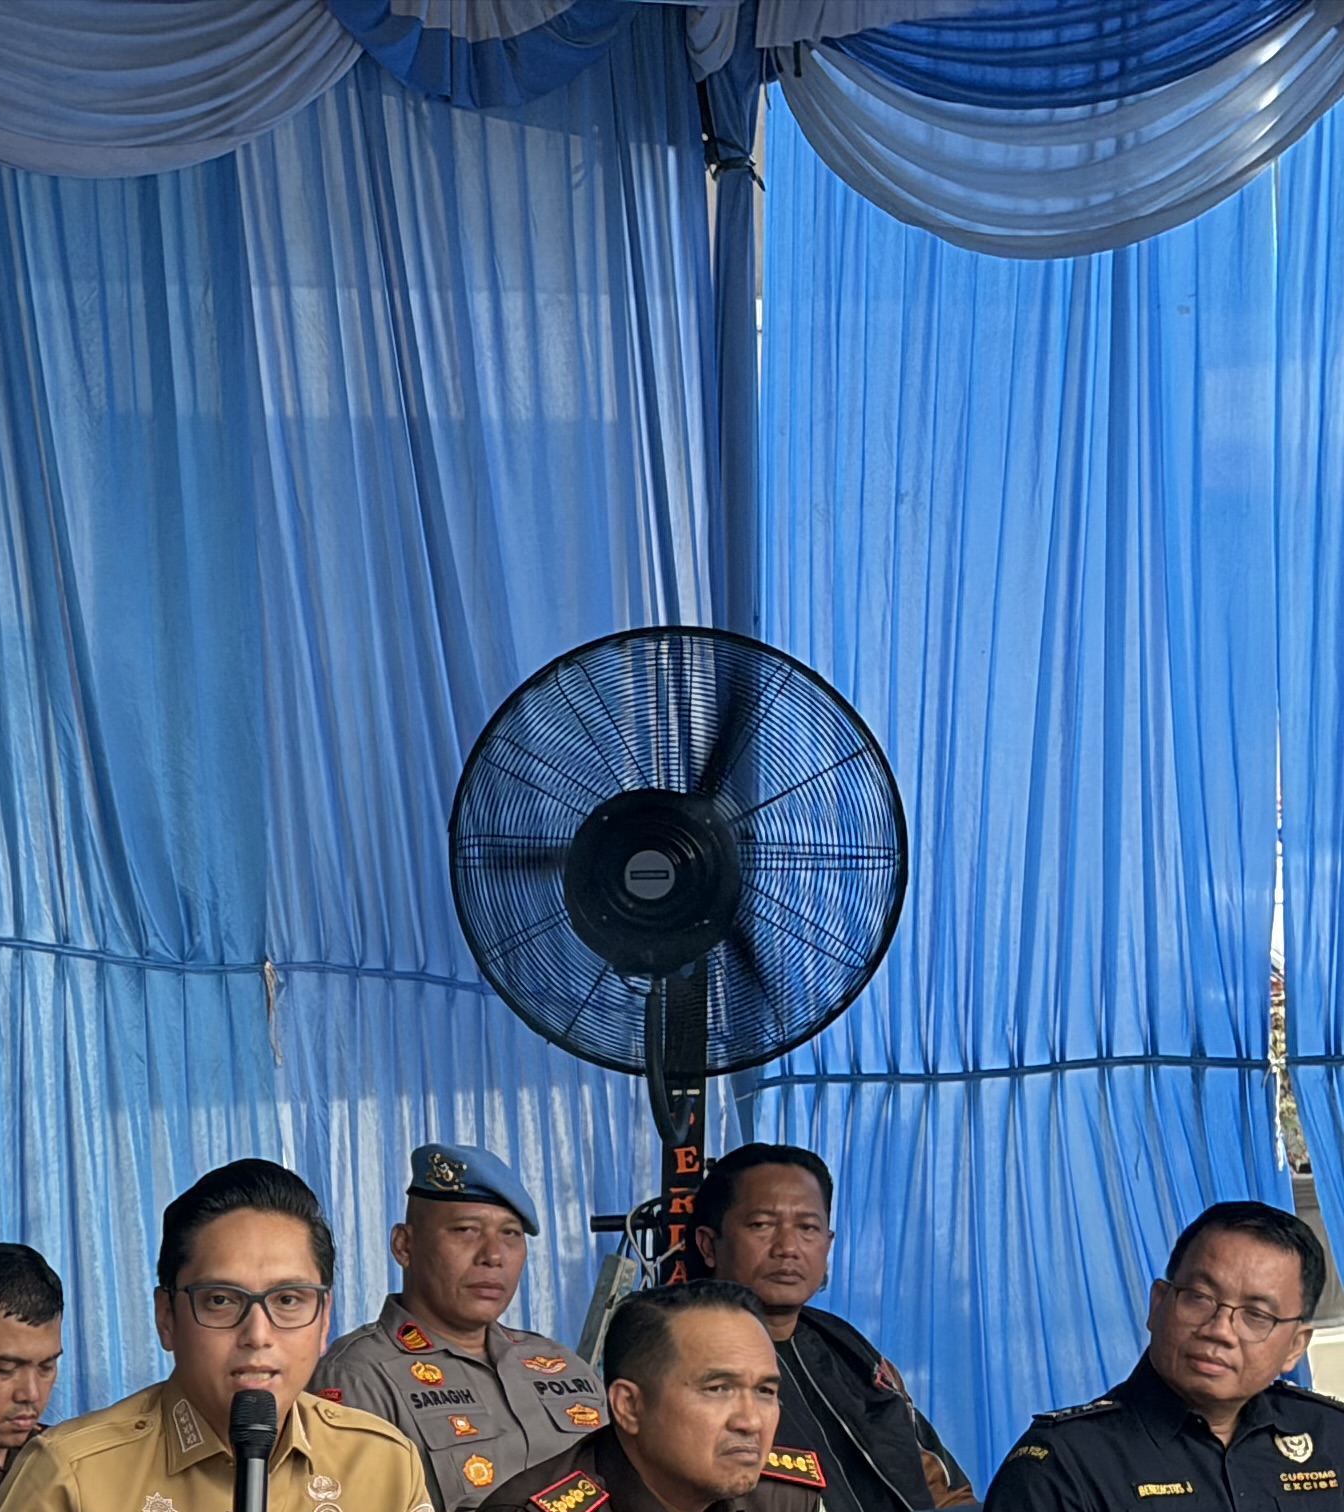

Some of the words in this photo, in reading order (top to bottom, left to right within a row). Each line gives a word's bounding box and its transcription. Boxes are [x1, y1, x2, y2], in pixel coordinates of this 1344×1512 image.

[532, 1377, 594, 1396] POLRI
[410, 1388, 476, 1409] SARAGIH
[1279, 1470, 1337, 1482] CUSTOMS
[1283, 1479, 1339, 1491] EXCISE
